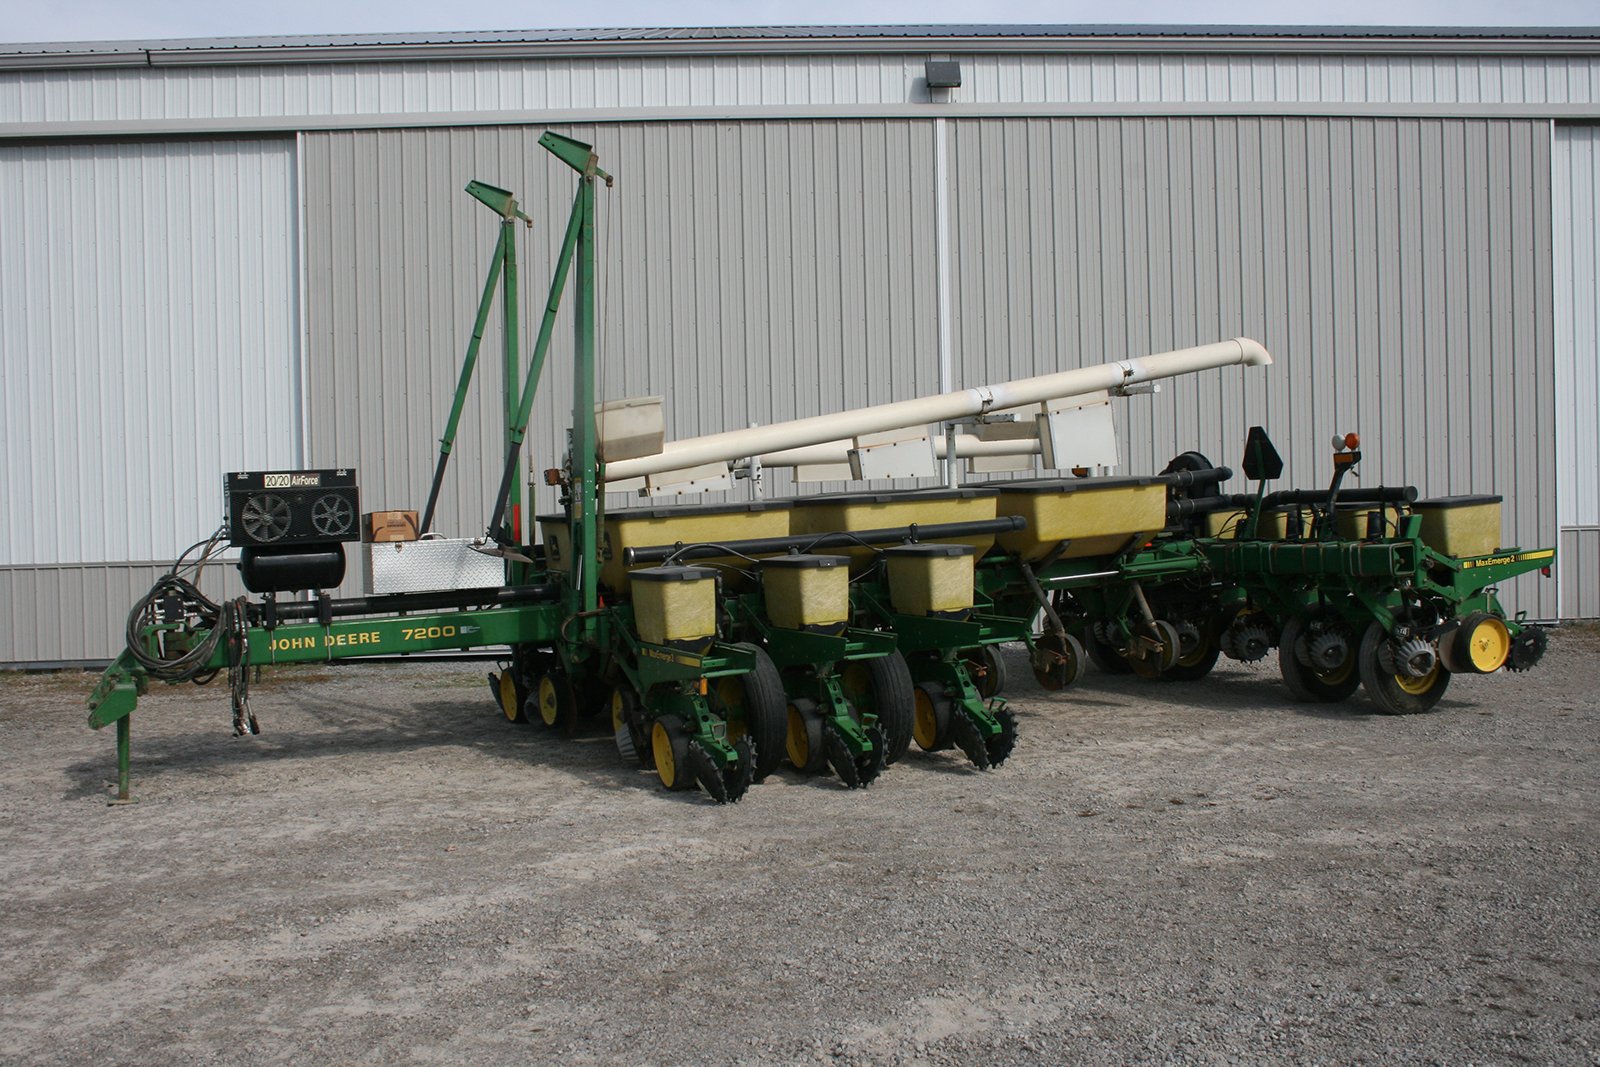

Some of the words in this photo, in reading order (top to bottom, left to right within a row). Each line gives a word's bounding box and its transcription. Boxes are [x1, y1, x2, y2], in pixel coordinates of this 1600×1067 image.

[266, 475, 290, 487] 20/20
[291, 475, 319, 486] AirForce
[1475, 557, 1510, 567] MaxEmerge
[1510, 555, 1515, 563] 2
[268, 636, 315, 651] JOHN
[324, 631, 380, 647] DEERE
[402, 625, 456, 641] 7200
